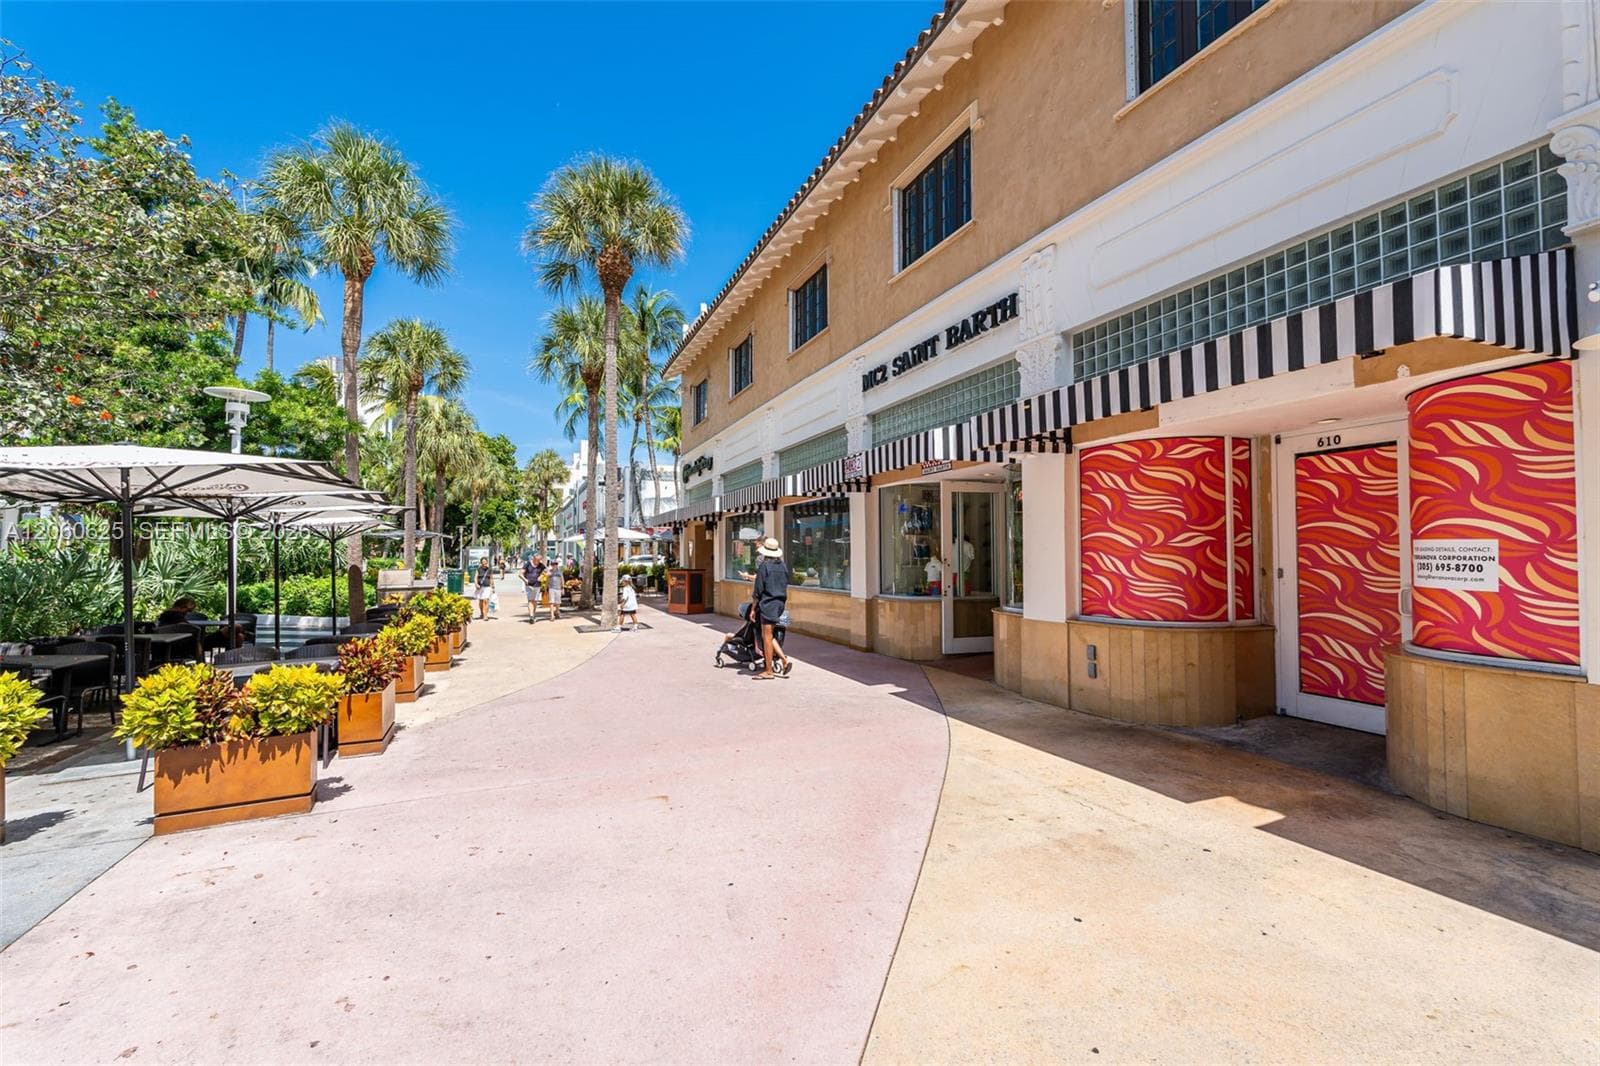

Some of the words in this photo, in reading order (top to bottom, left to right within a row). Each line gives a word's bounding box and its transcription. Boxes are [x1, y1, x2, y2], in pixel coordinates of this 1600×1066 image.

[862, 364, 888, 393] MC2
[892, 334, 940, 377] SAINT
[945, 293, 1019, 350] BARTH
[1317, 434, 1342, 448] 610
[1438, 554, 1496, 562] CORPORATION
[1435, 563, 1484, 573] 695-8700
